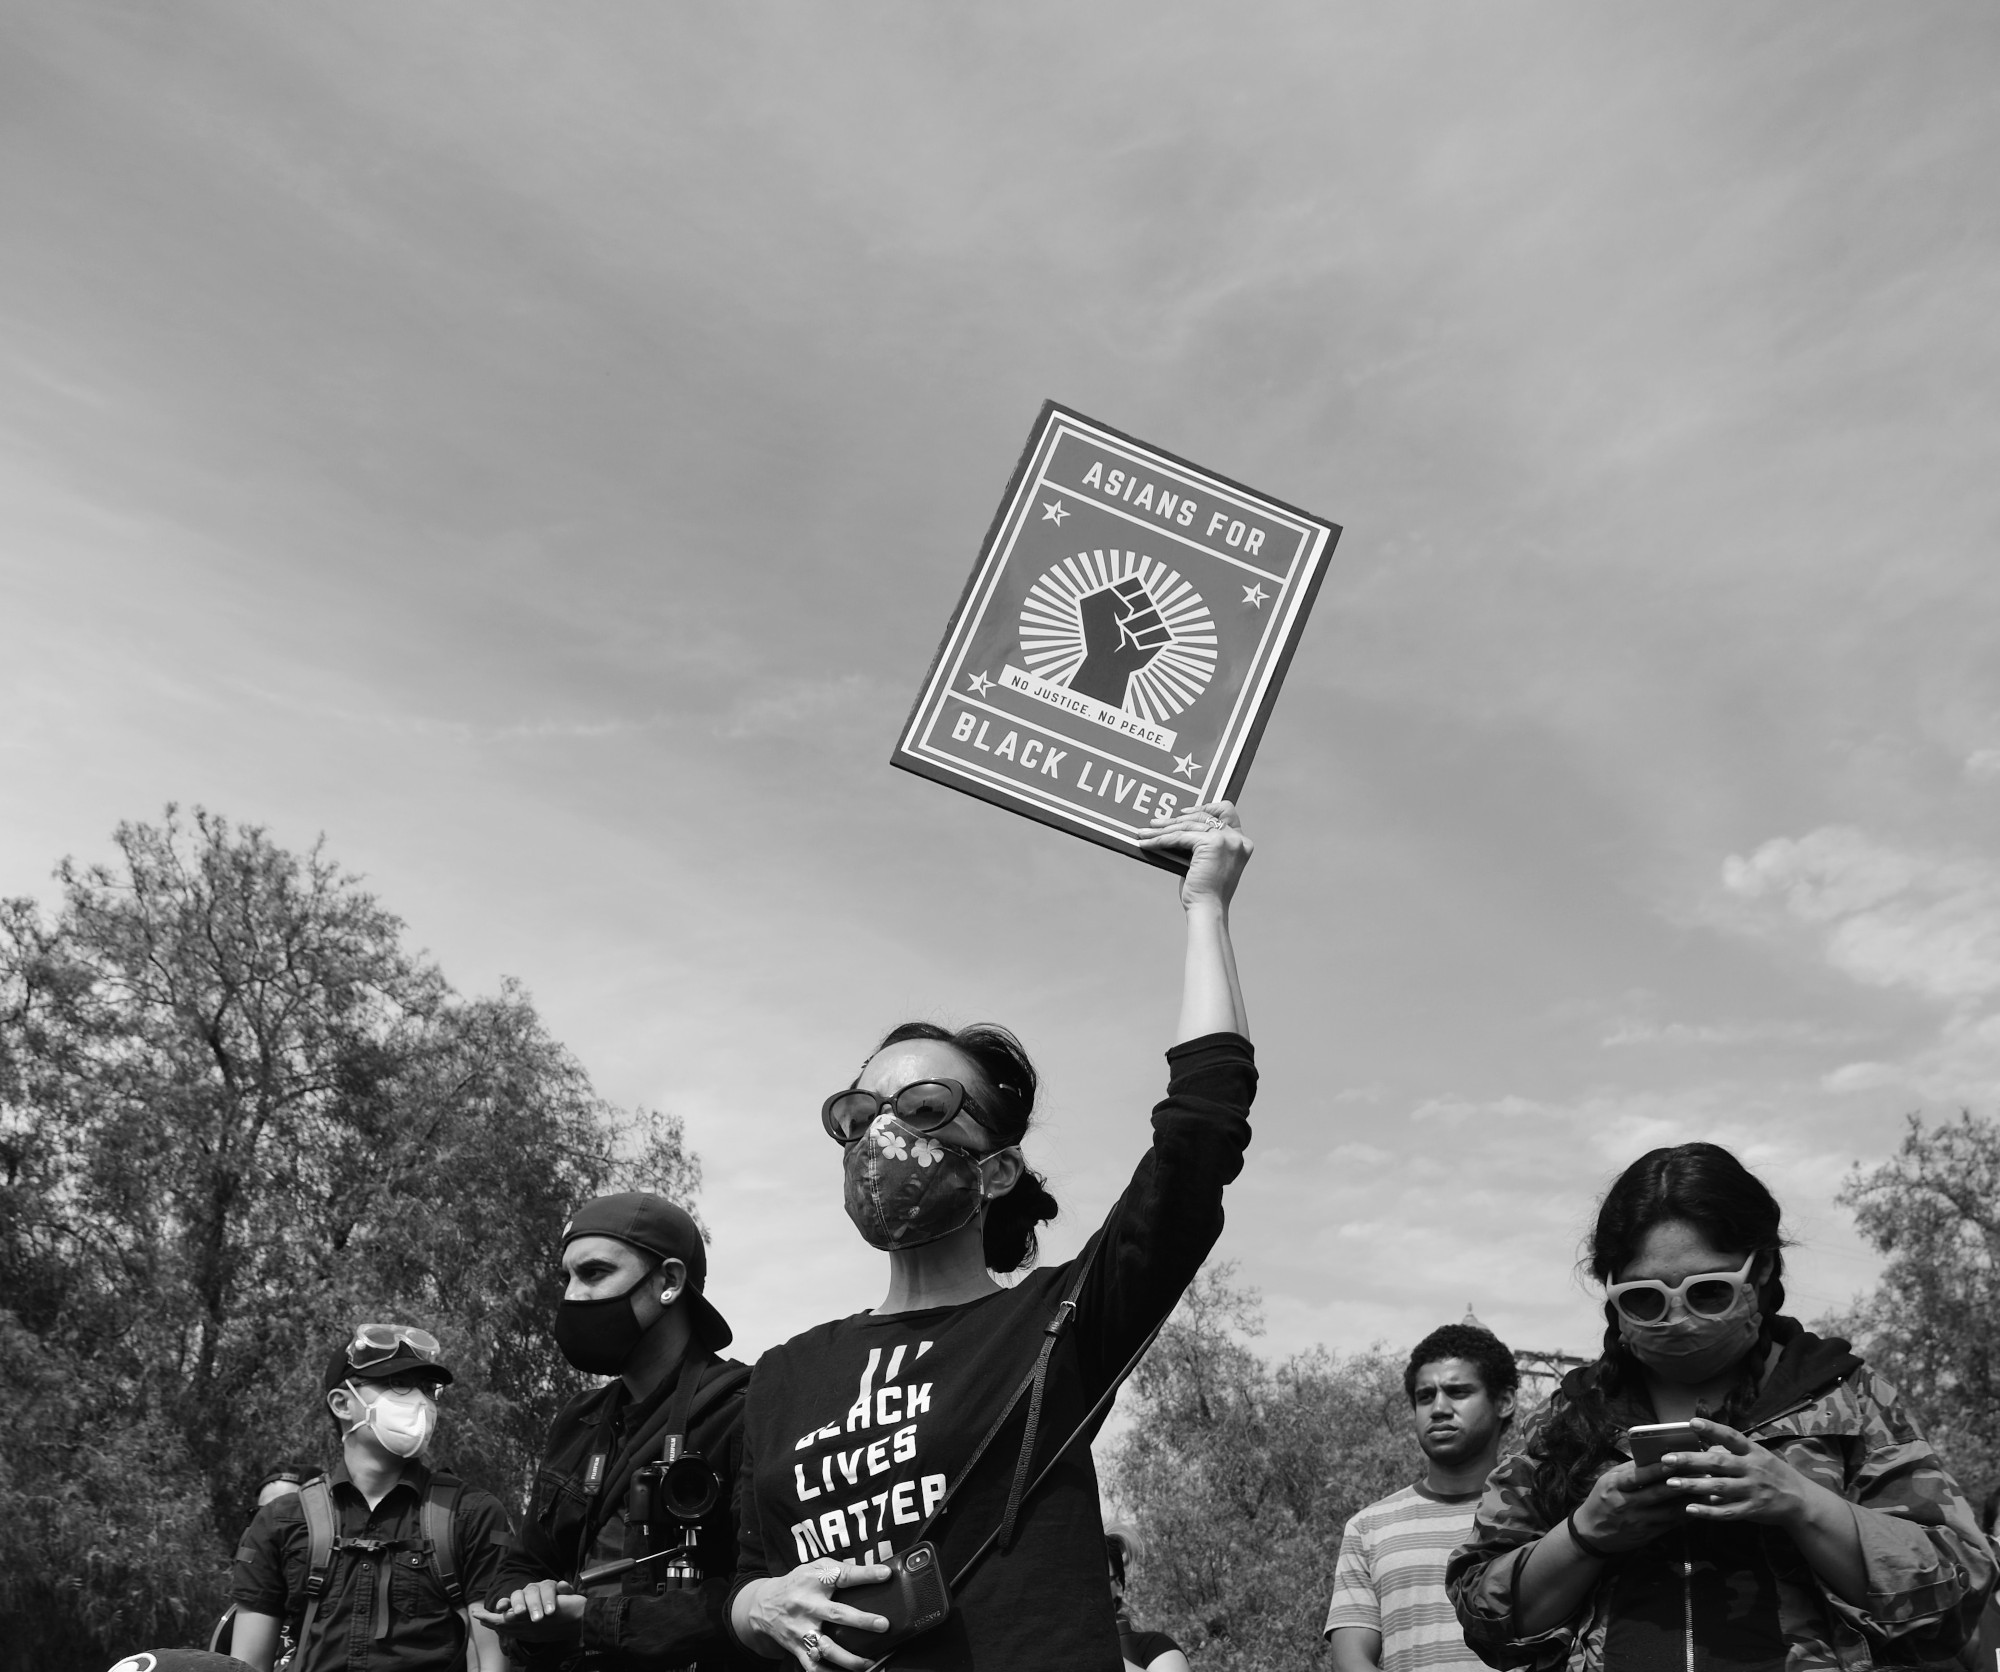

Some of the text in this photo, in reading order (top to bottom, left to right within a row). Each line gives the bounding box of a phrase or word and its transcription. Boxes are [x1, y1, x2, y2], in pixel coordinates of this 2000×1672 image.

[1081, 461, 1266, 556] ASIANS FOR
[1011, 675, 1166, 747] NO JUSTICE. NO PEACE.
[951, 711, 1178, 820] BLACK LIVES
[669, 1437, 677, 1462] FUJIFILM
[794, 1424, 917, 1502] LIVES
[790, 1473, 948, 1564] MATTER
